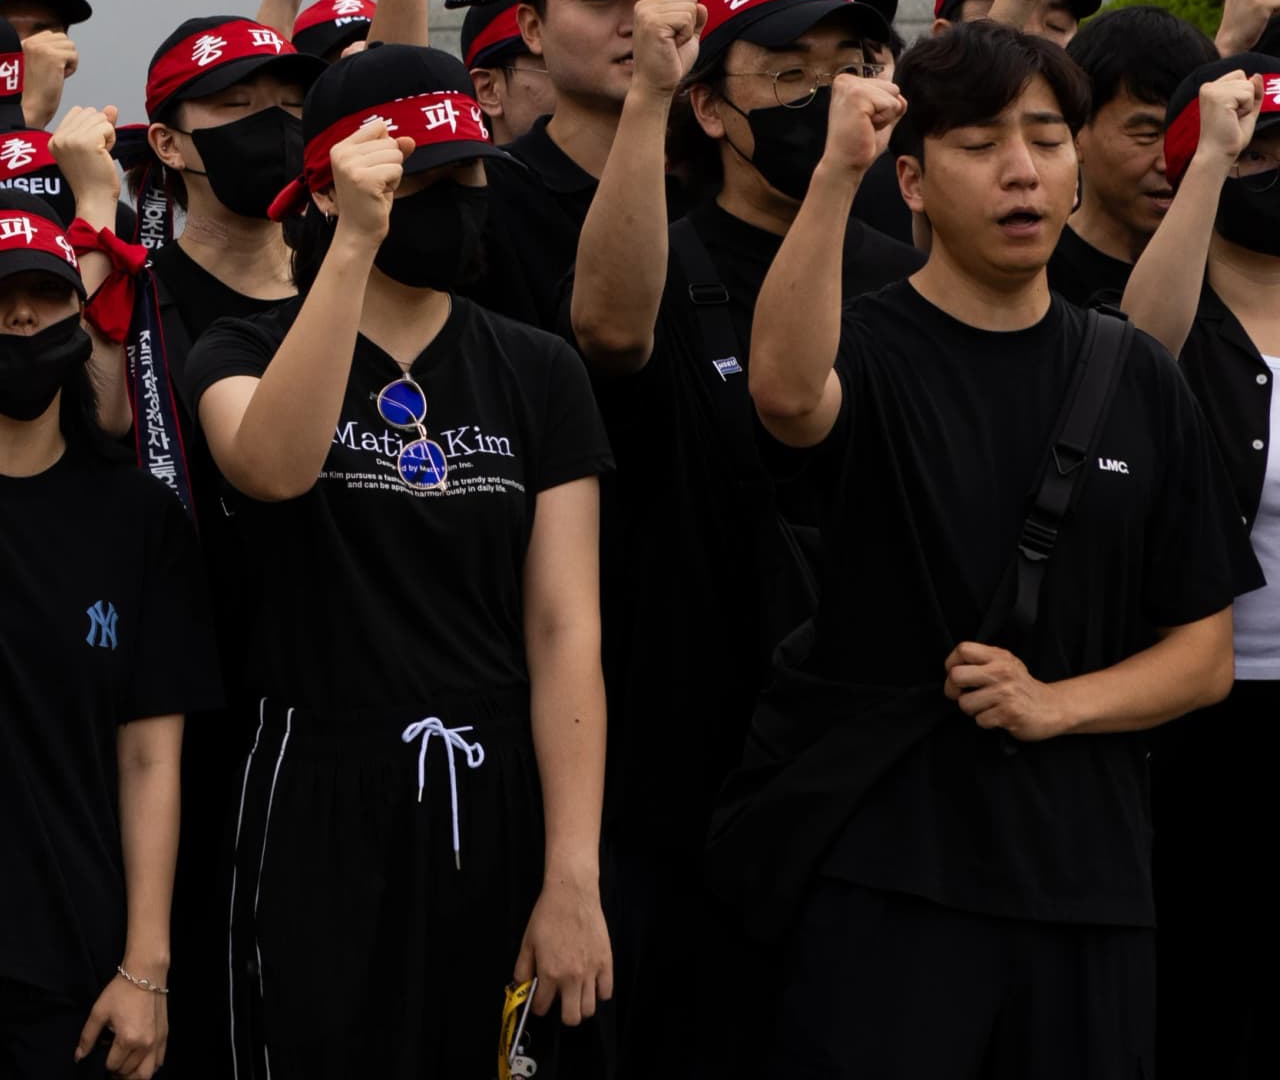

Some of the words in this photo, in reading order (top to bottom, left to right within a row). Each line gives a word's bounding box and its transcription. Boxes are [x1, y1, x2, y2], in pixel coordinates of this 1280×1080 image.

[439, 426, 514, 459] Kim
[347, 481, 363, 489] and
[380, 482, 390, 490] be
[461, 477, 486, 486] trendy
